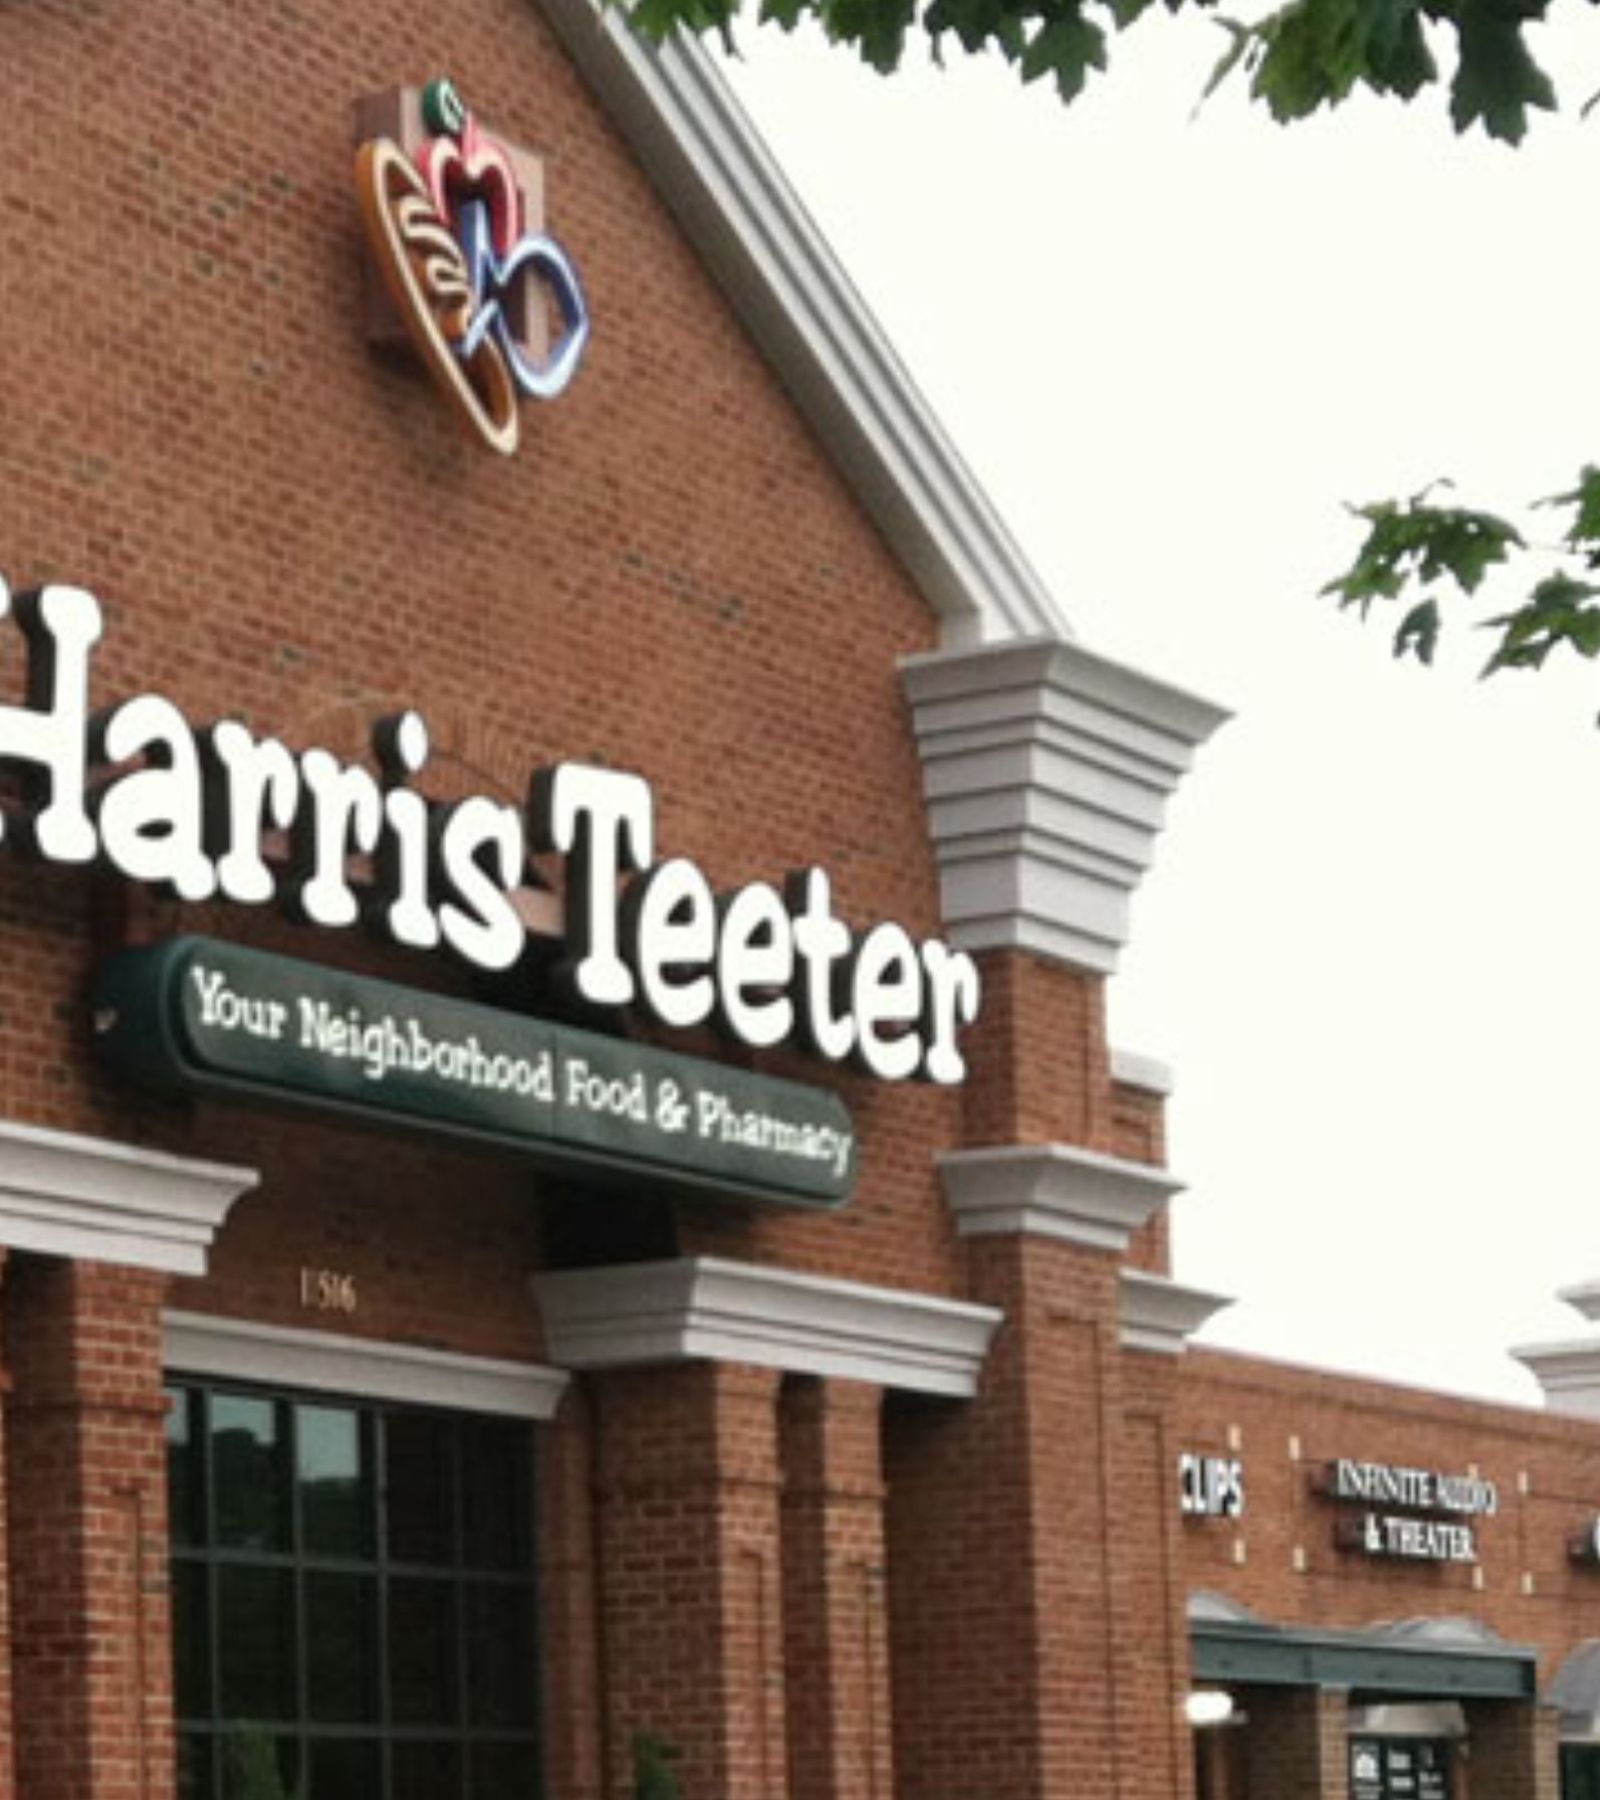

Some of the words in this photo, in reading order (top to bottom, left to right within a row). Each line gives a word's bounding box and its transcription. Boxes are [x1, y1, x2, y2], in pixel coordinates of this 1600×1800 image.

[550, 761, 979, 1084] Teeter
[193, 969, 288, 1034] Your
[296, 997, 555, 1104] Neighborhood
[565, 1060, 648, 1124] Food
[657, 1080, 691, 1135] &
[696, 1091, 854, 1179] Pharmacy
[1178, 1453, 1242, 1517] CLIPS
[1337, 1458, 1433, 1507] INFINITE
[1364, 1512, 1383, 1552] &
[1383, 1517, 1477, 1563] THEATER
